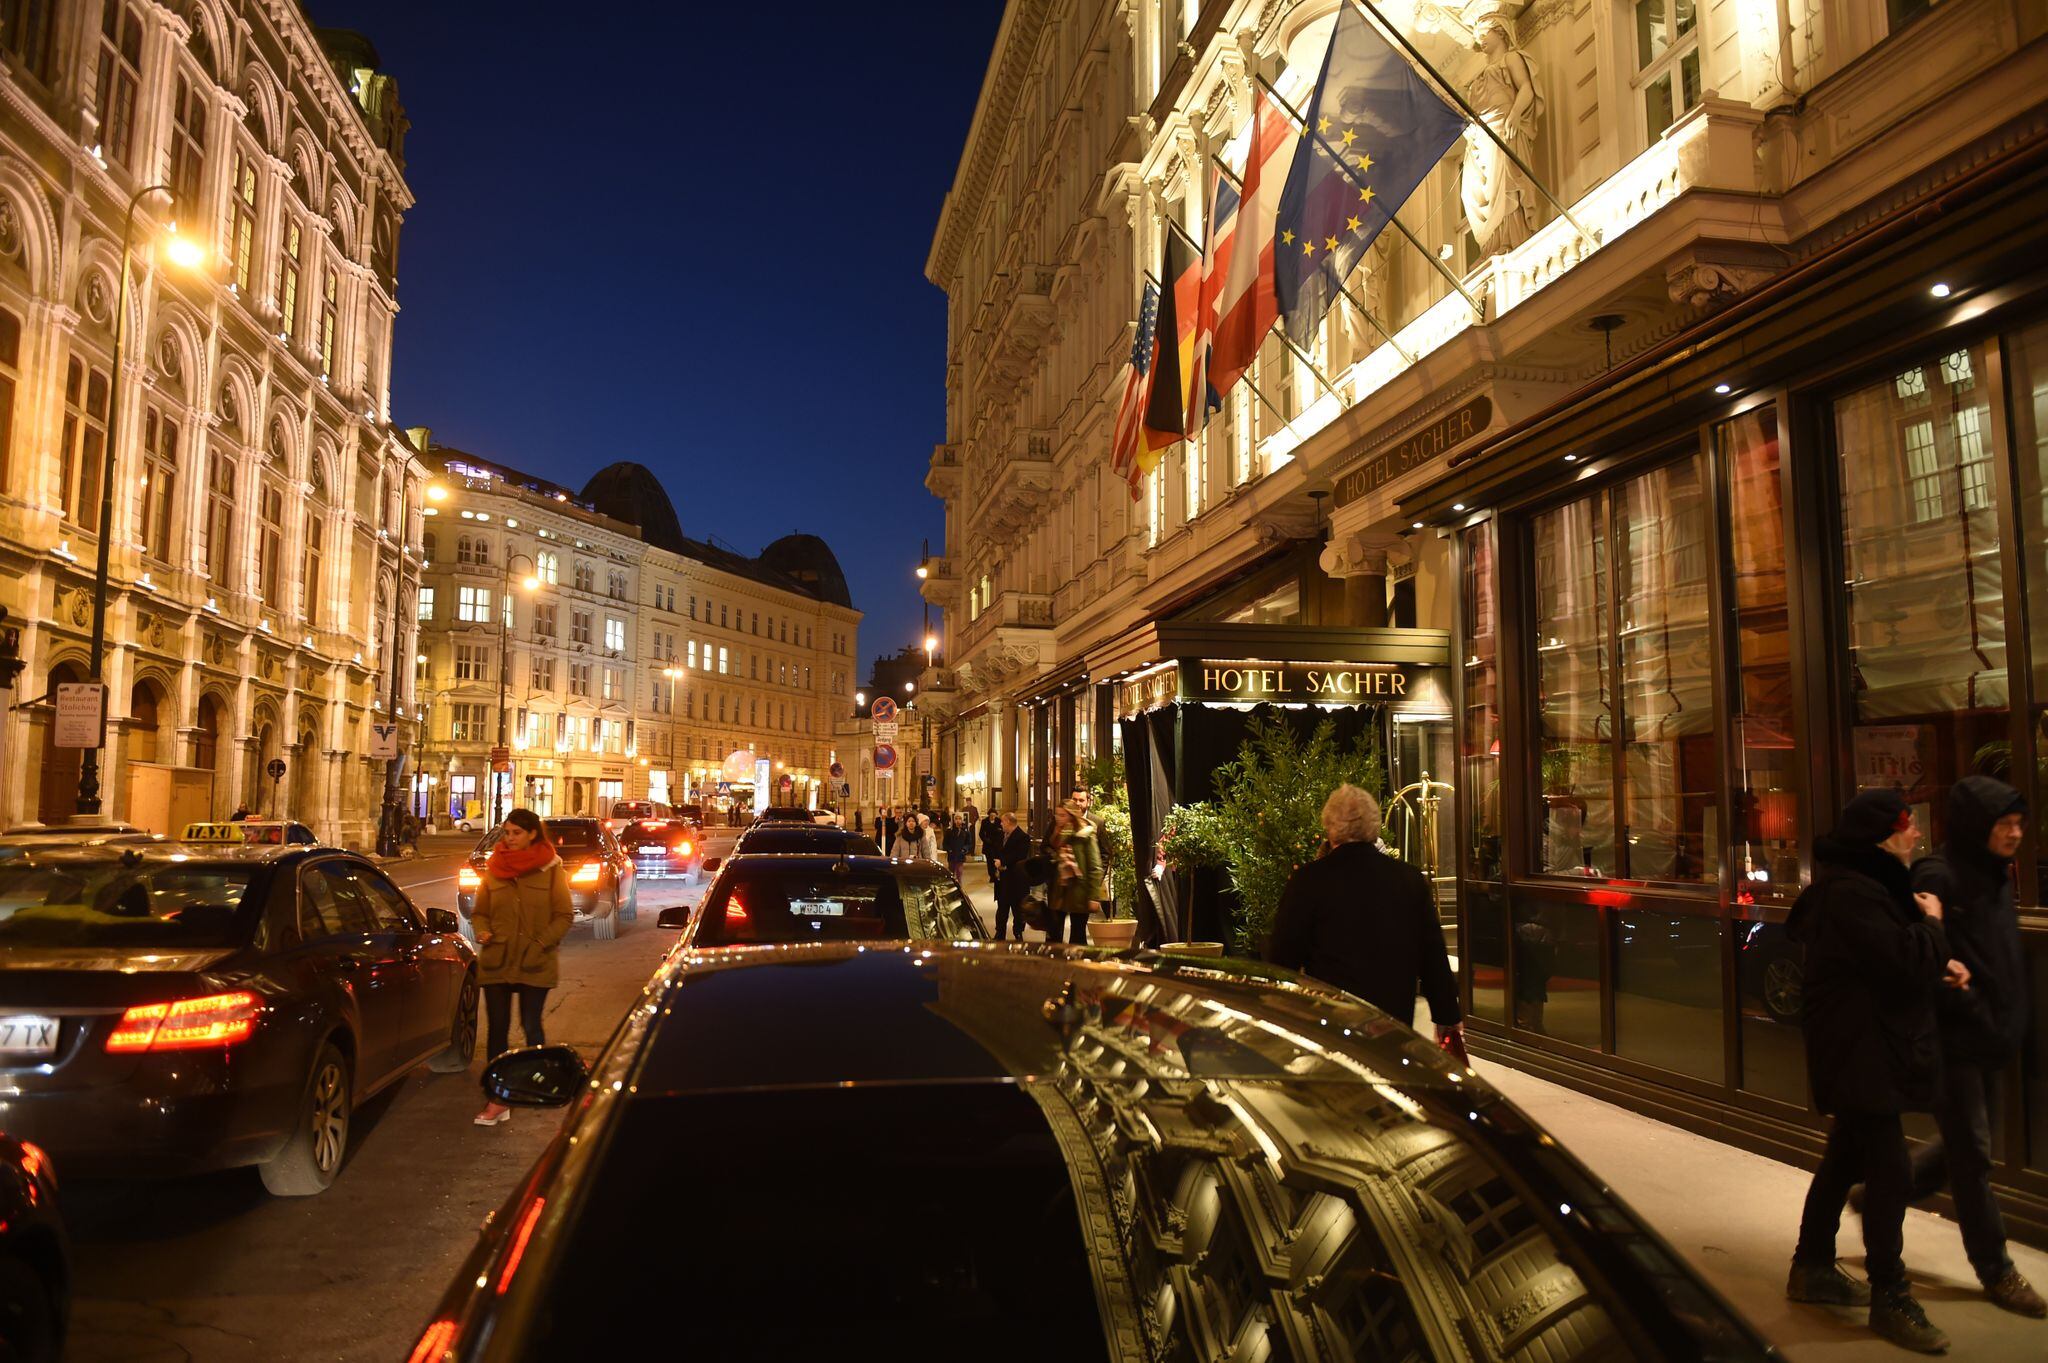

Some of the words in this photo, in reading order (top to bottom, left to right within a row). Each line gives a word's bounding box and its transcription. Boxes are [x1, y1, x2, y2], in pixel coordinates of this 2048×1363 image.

[1345, 456, 1394, 500] HOTEL
[1400, 409, 1474, 471] SACHER
[1121, 682, 1143, 707] HOTEL
[1146, 670, 1176, 700] SACHER
[1203, 668, 1292, 693] HOTEL
[1306, 670, 1406, 695] SACHER
[60, 695, 98, 703] Restaurant
[189, 826, 231, 839] TAXI
[24, 1024, 53, 1046] TX
